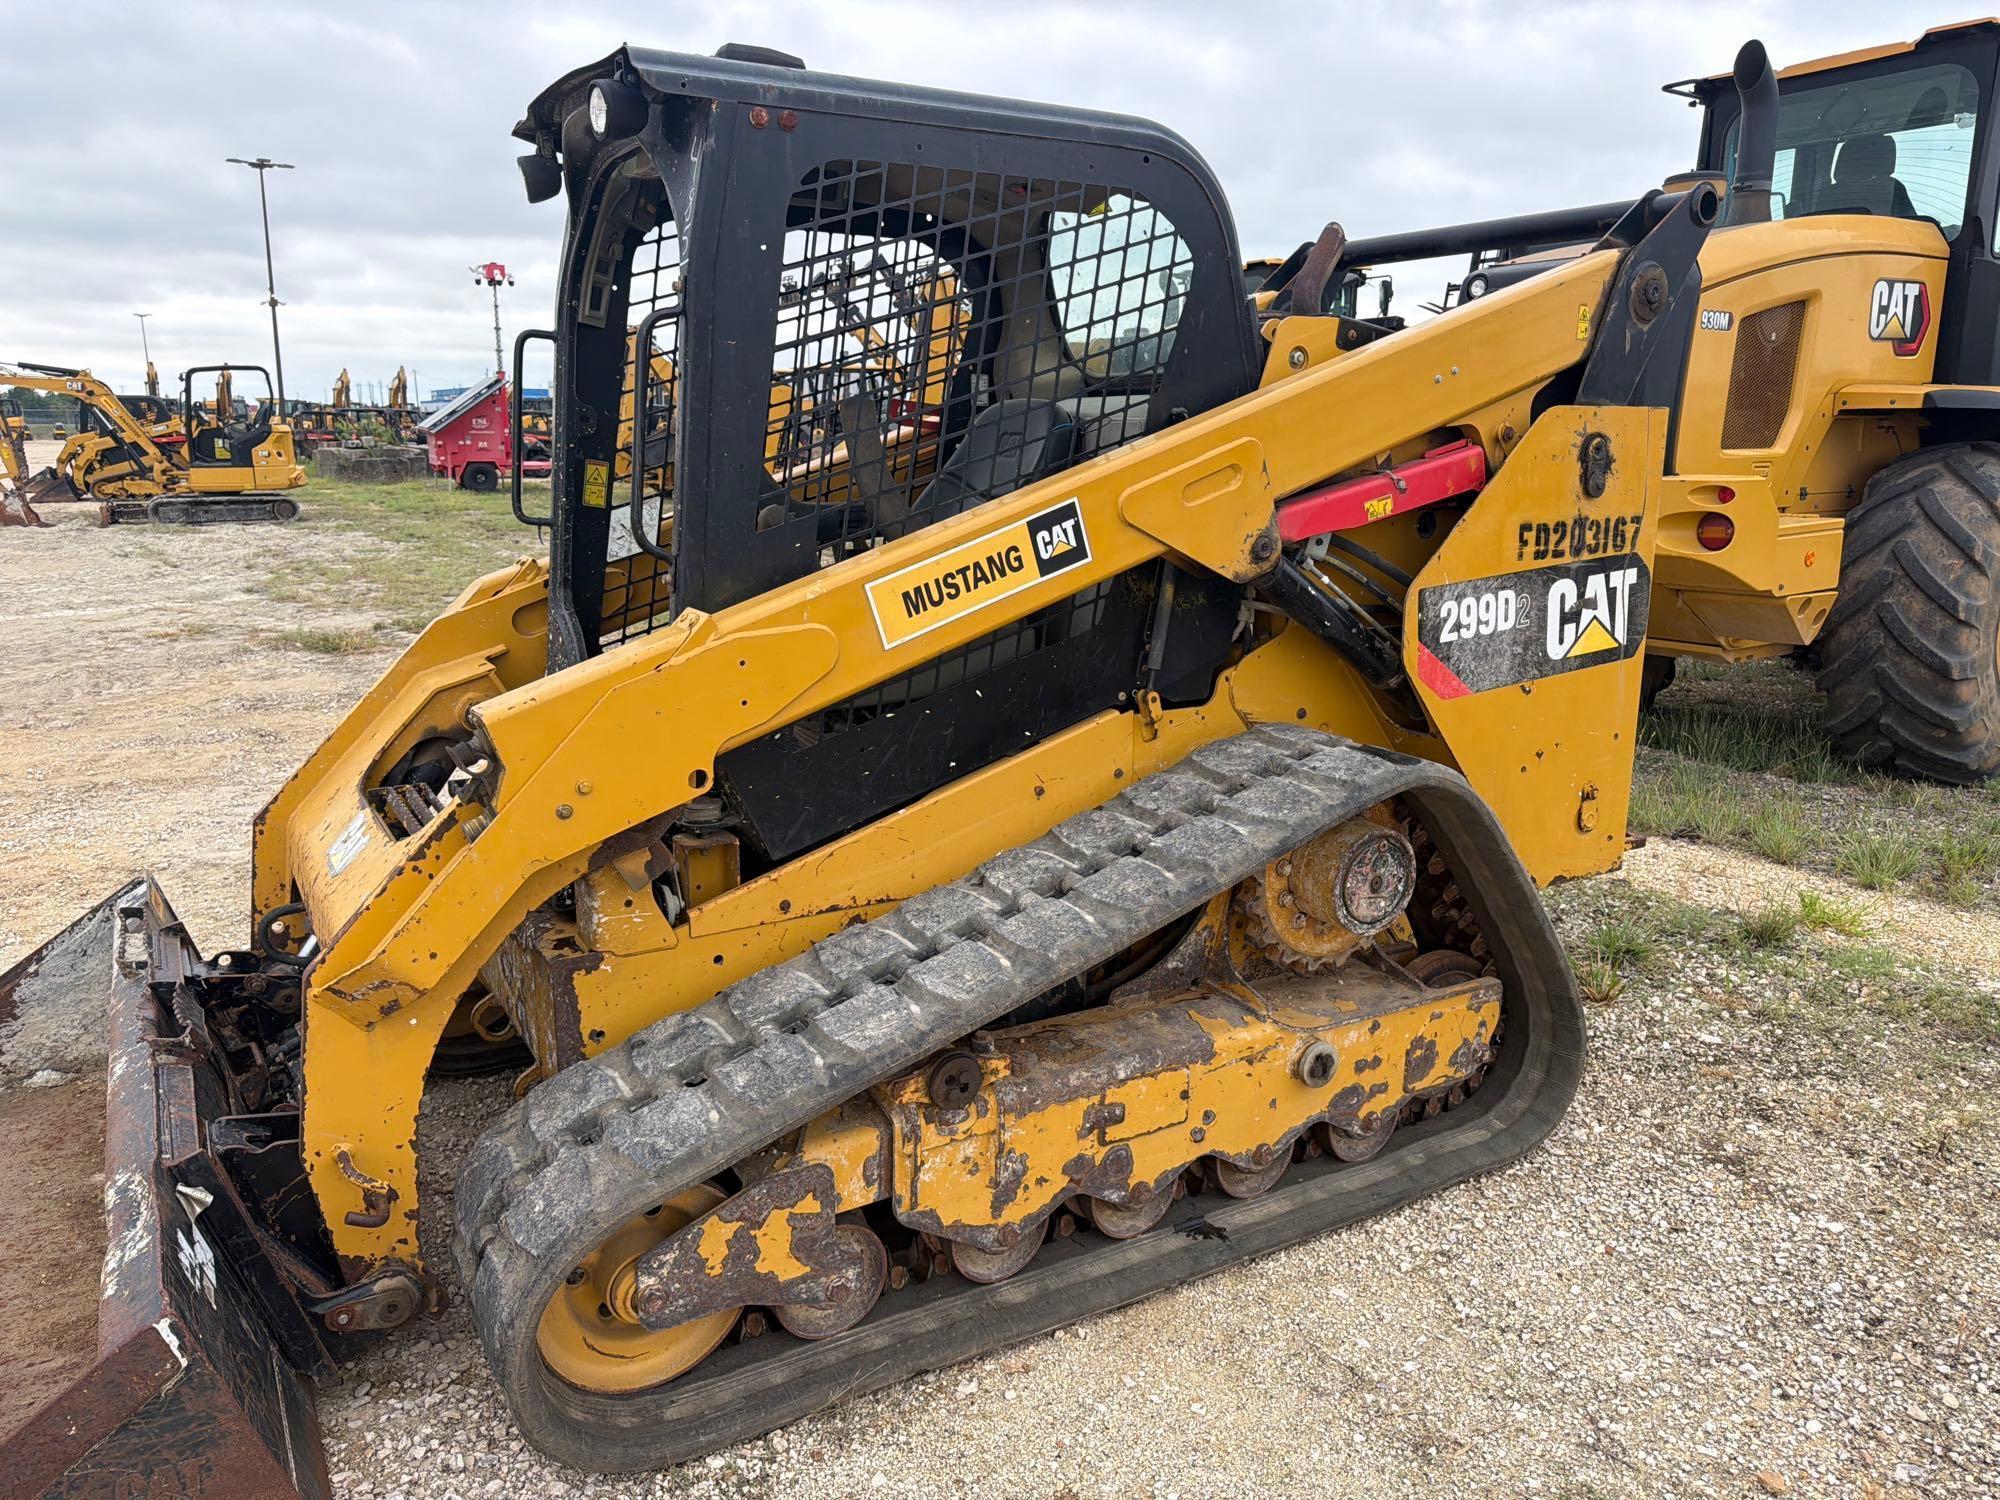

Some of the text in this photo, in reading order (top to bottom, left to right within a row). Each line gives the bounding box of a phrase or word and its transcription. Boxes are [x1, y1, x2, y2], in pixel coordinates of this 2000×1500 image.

[1701, 311, 1730, 330] 930M
[1870, 281, 1921, 339] CAT
[66, 381, 82, 391] CAT
[1517, 515, 1641, 561] FD203167
[901, 518, 1077, 618] MUSTANG CAT
[1547, 568, 1638, 660] CAT
